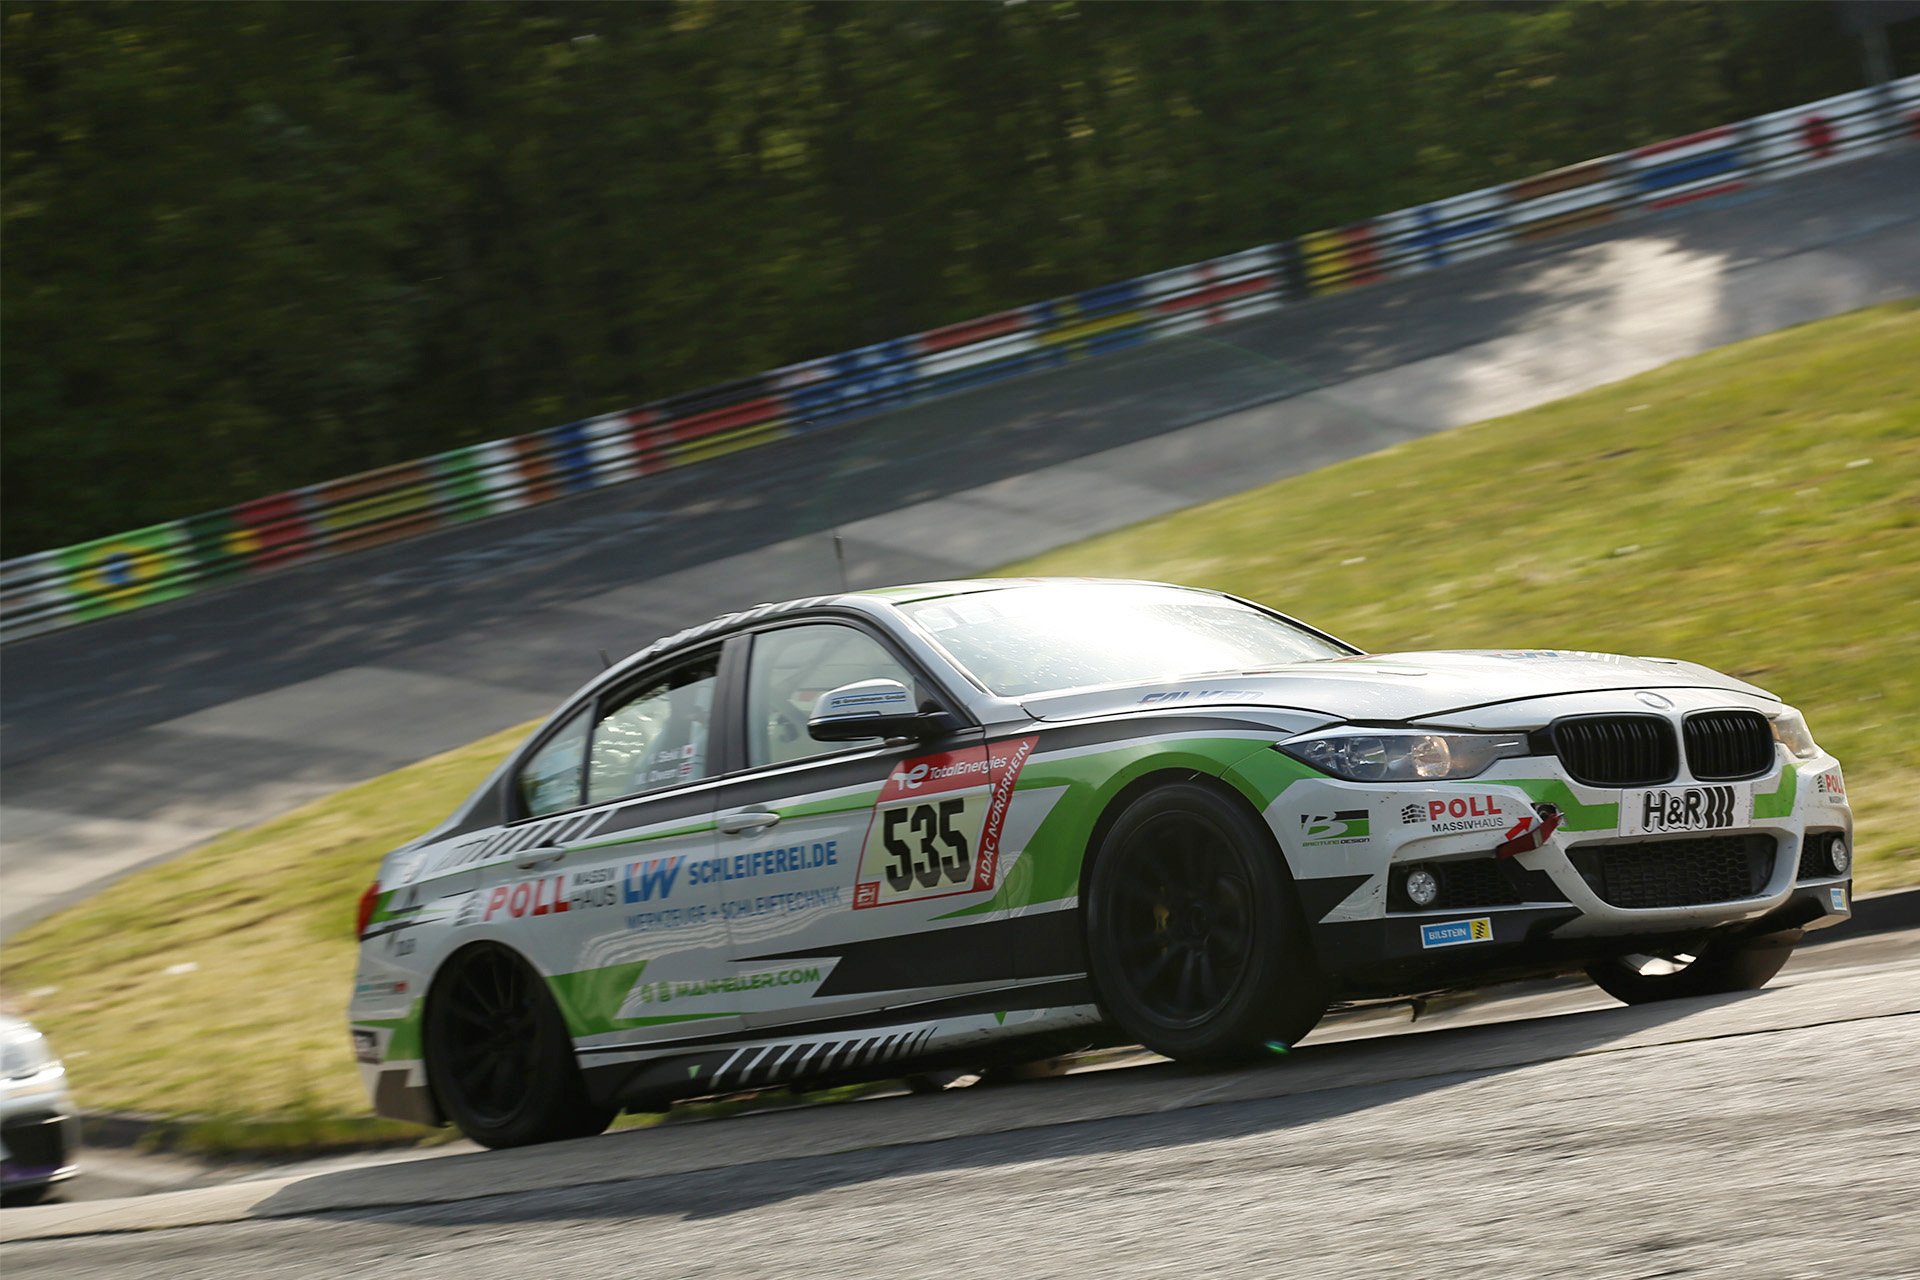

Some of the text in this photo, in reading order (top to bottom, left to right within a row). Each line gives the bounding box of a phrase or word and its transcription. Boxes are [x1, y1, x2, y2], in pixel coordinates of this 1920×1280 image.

[929, 756, 1007, 779] TotalEnergies
[979, 740, 1030, 886] ADAC NORDRHEIN
[1428, 795, 1502, 821] POLL
[1431, 817, 1504, 833] MASSIVHAUS
[1642, 788, 1703, 831] H&R
[883, 797, 971, 892] 535
[623, 841, 838, 904] LW SCHLEIFEREI.DE
[483, 875, 571, 922] POLL
[1428, 927, 1467, 941] BILSTEIN
